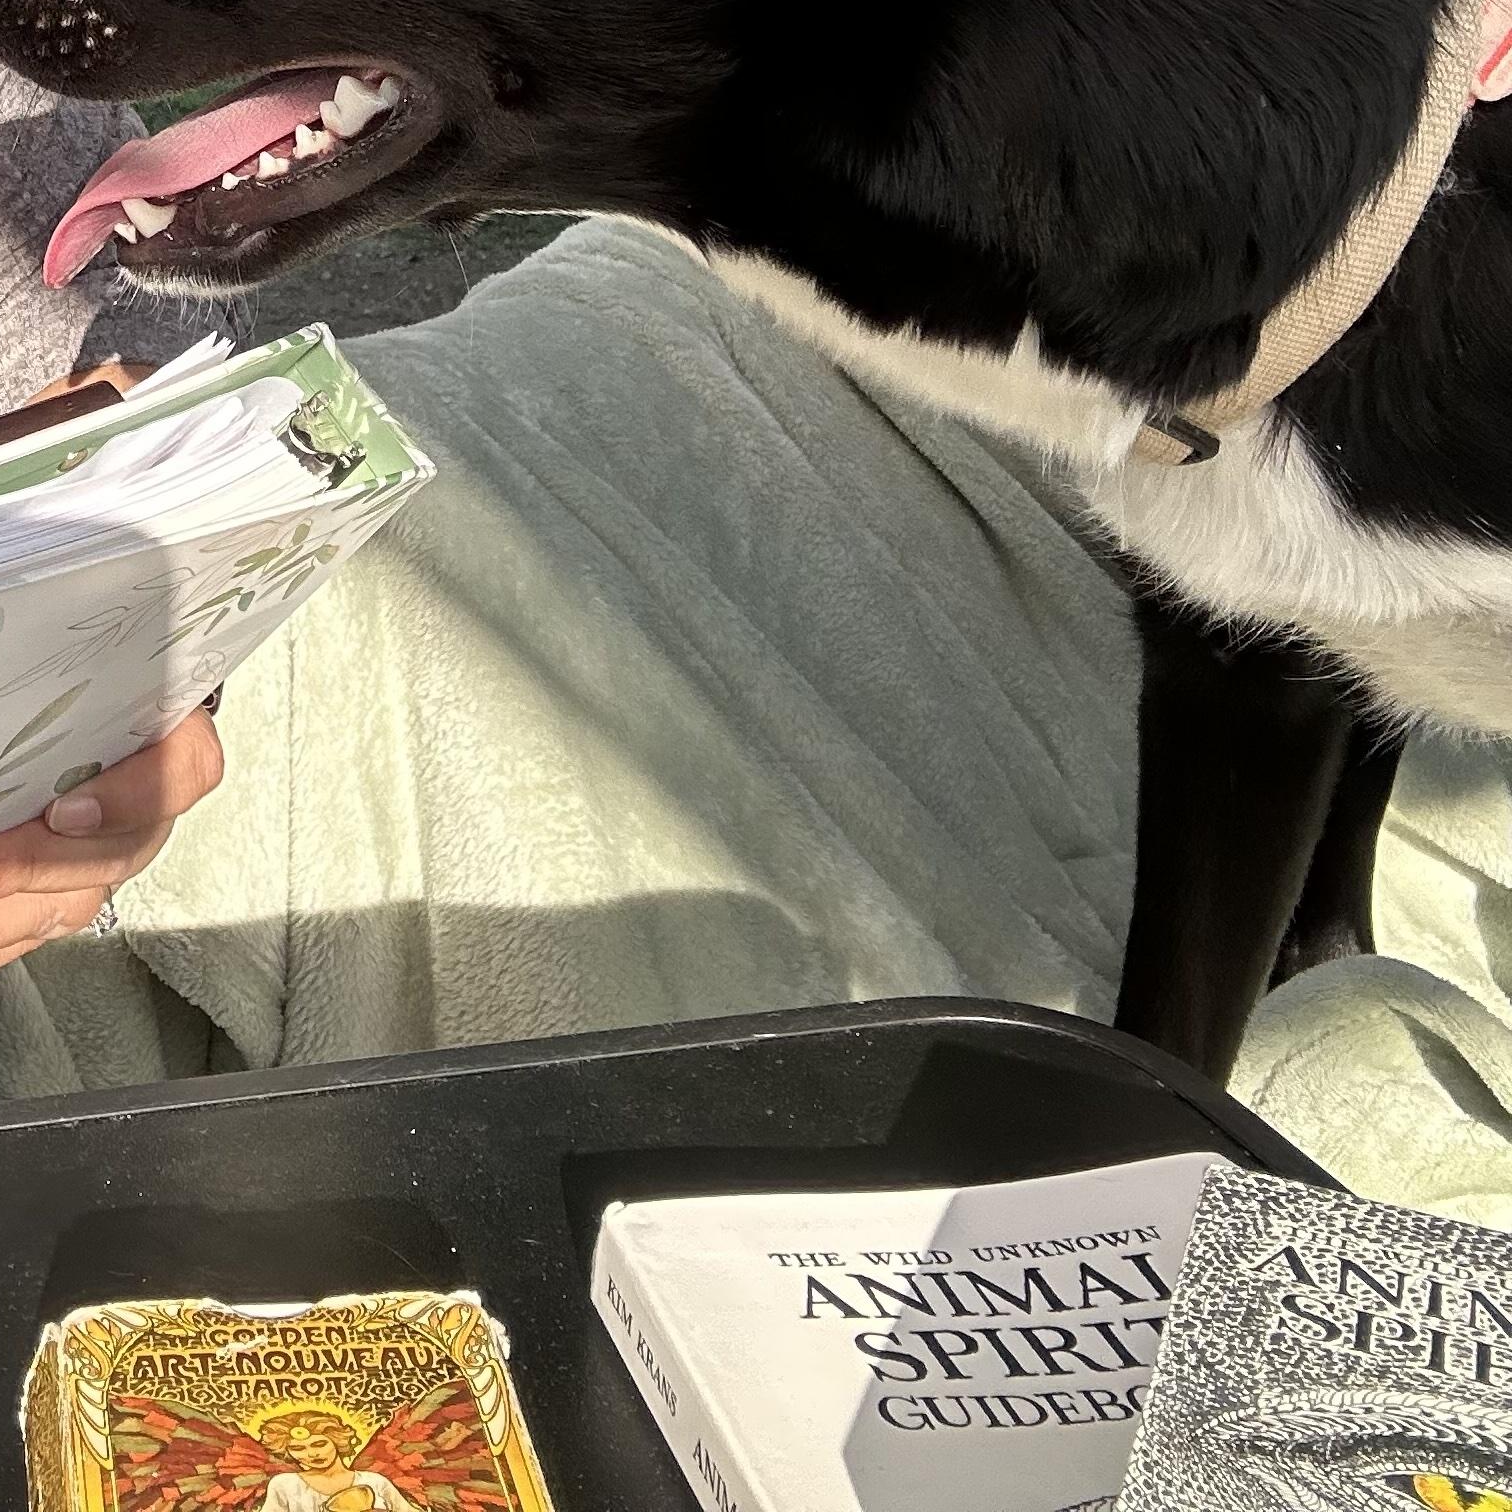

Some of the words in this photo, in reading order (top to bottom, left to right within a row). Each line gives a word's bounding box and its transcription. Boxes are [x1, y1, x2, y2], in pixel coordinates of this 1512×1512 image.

[767, 1251, 847, 1269] THE
[861, 1248, 954, 1267] WILD
[969, 1224, 1163, 1264] UNKNOWN
[132, 1352, 219, 1379] ART
[235, 1345, 442, 1377] NOUVEAU
[606, 1274, 634, 1338] KIM
[636, 1329, 678, 1418] KRANS
[231, 1374, 353, 1399] TAROT
